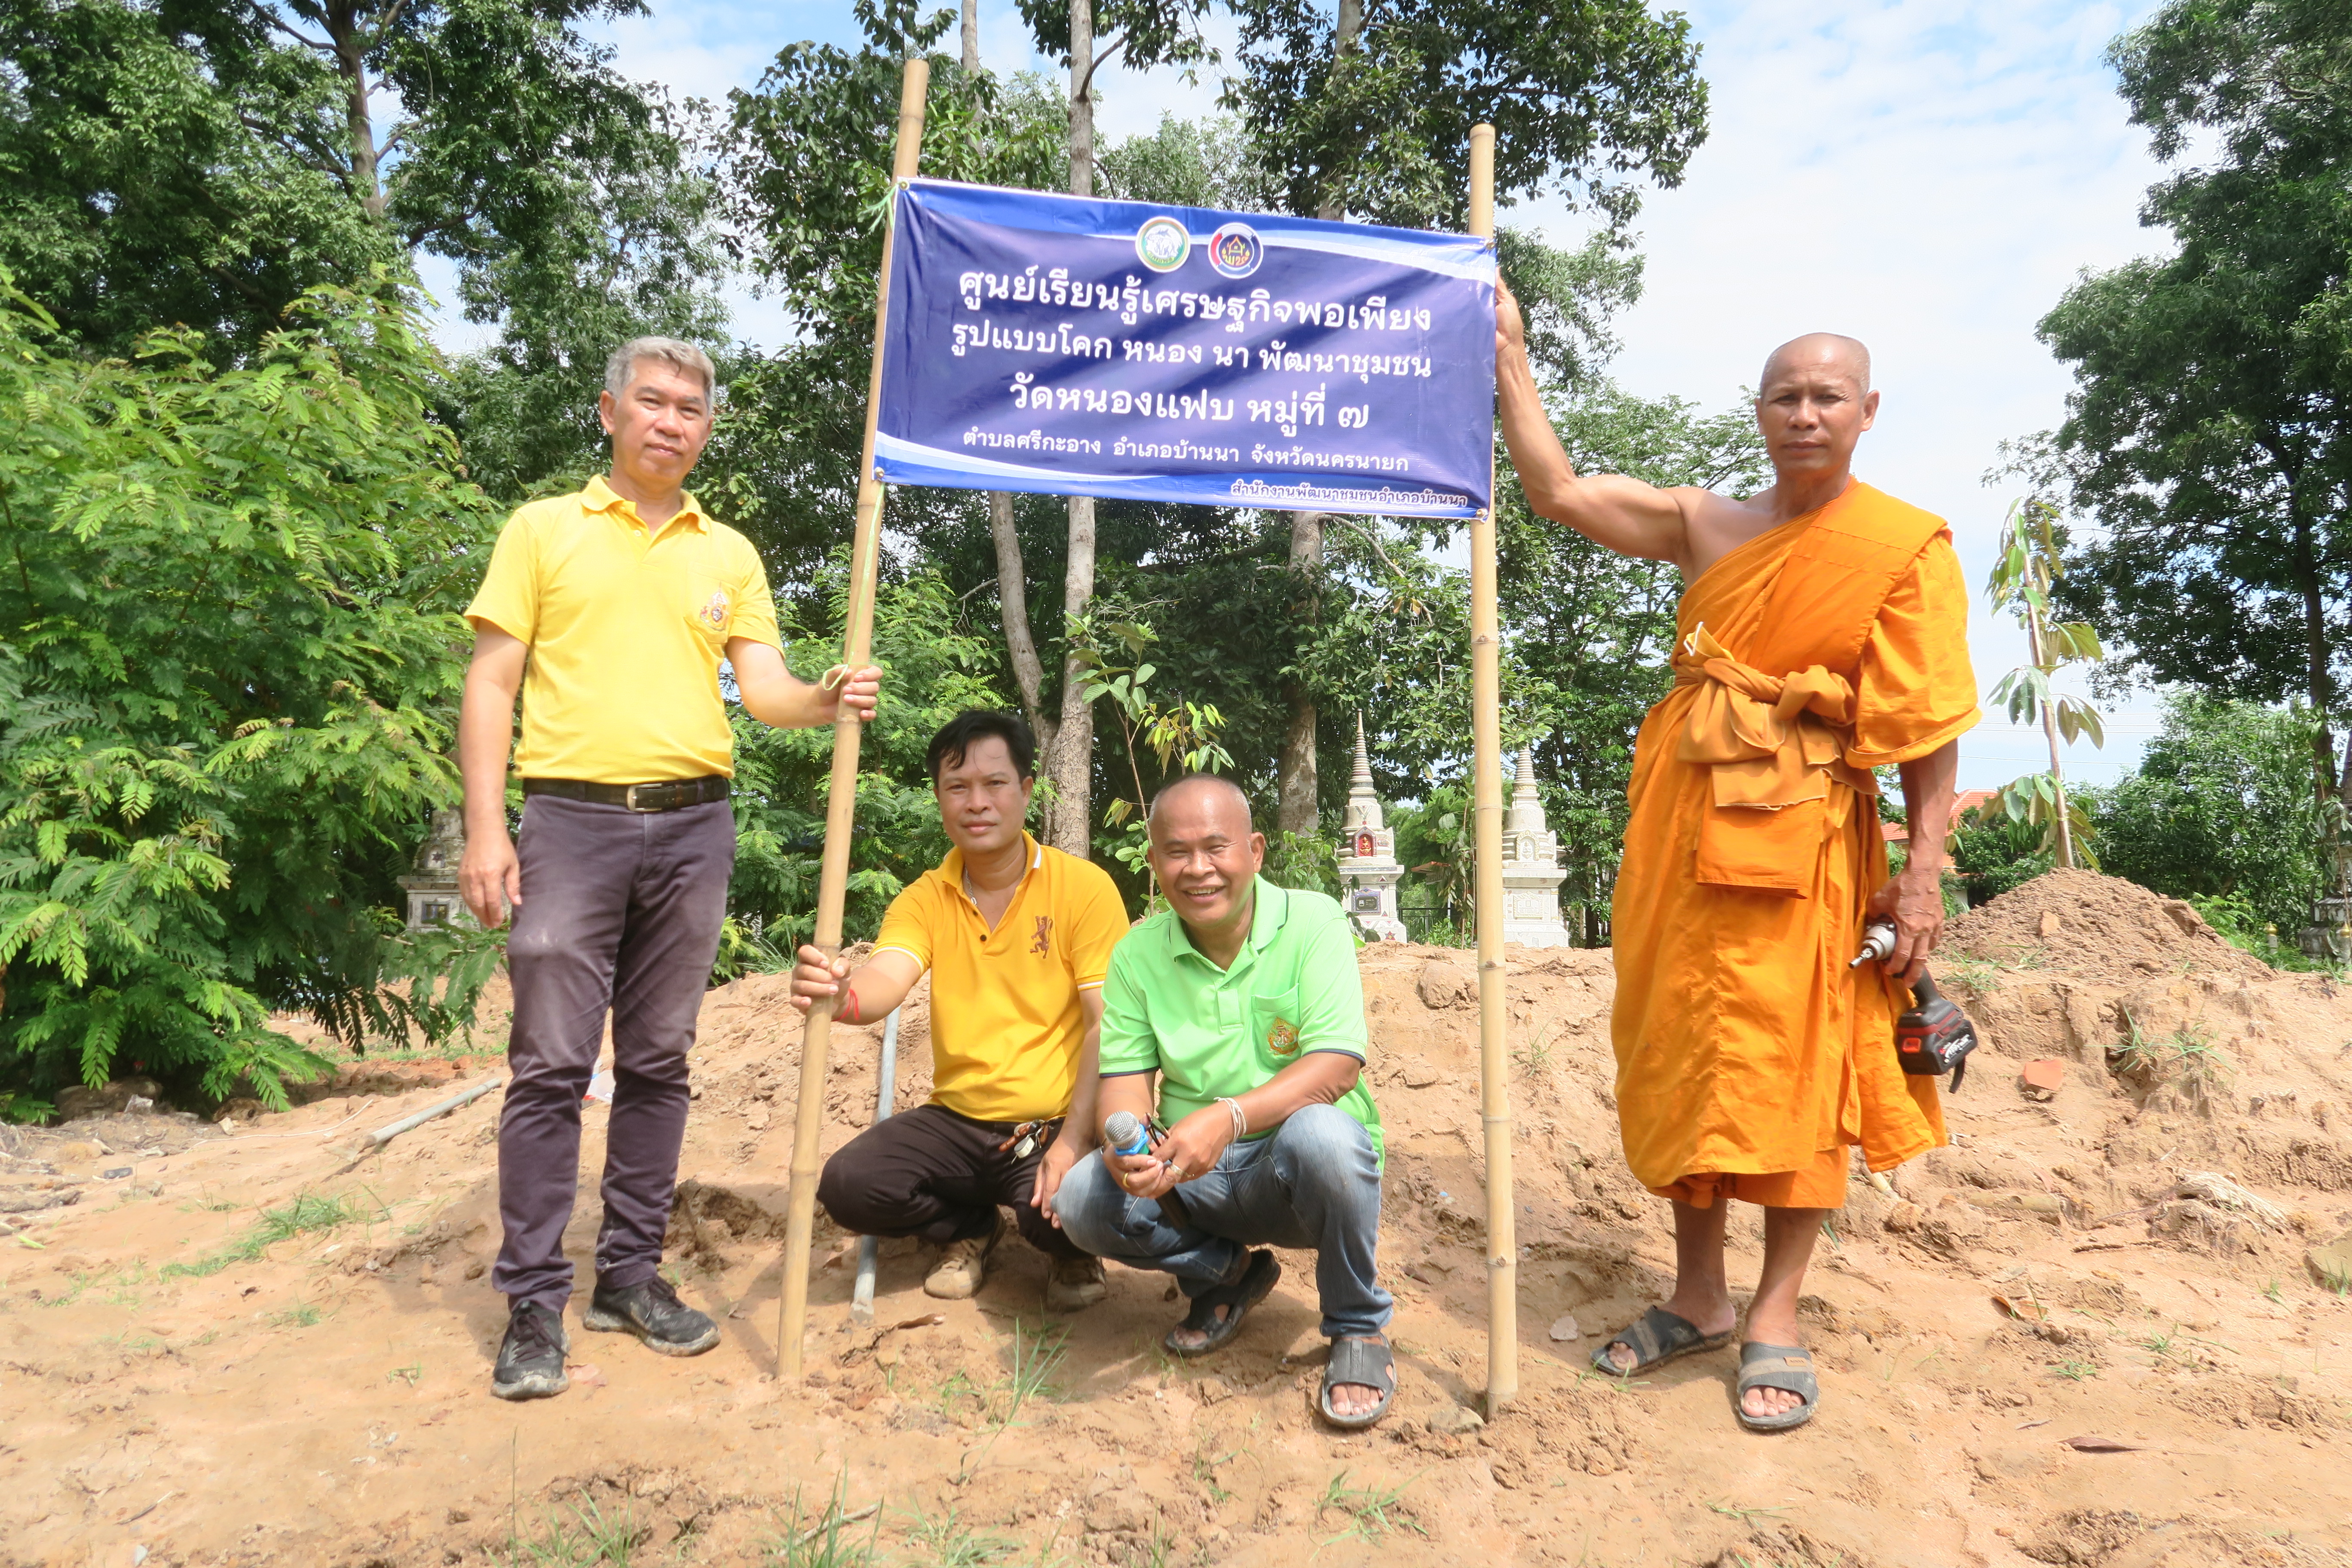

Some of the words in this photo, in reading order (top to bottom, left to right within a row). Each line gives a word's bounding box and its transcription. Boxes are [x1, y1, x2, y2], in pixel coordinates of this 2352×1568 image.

[959, 264, 1431, 333] ศูนย์เรียนรู้เศรษฐกิจพอเพียง
[951, 319, 1112, 359] รูปแบบโคก
[1123, 340, 1202, 364] หนอง
[1213, 345, 1249, 368] นา
[1259, 340, 1431, 383] พัฒนาชุมชน
[1009, 371, 1234, 420] วัดหนองแฟบ
[1247, 383, 1326, 437] หมู่ที่
[1338, 404, 1369, 429] ๗
[963, 426, 1101, 455] ตำบลศรีกะอาง
[1113, 436, 1239, 462] อำเภอบ้านนา
[1251, 444, 1409, 471] จังหวัดนครนายก
[1231, 478, 1467, 507] สำนักงานพัฒนาชุมชนอำเภอบ้านนา
